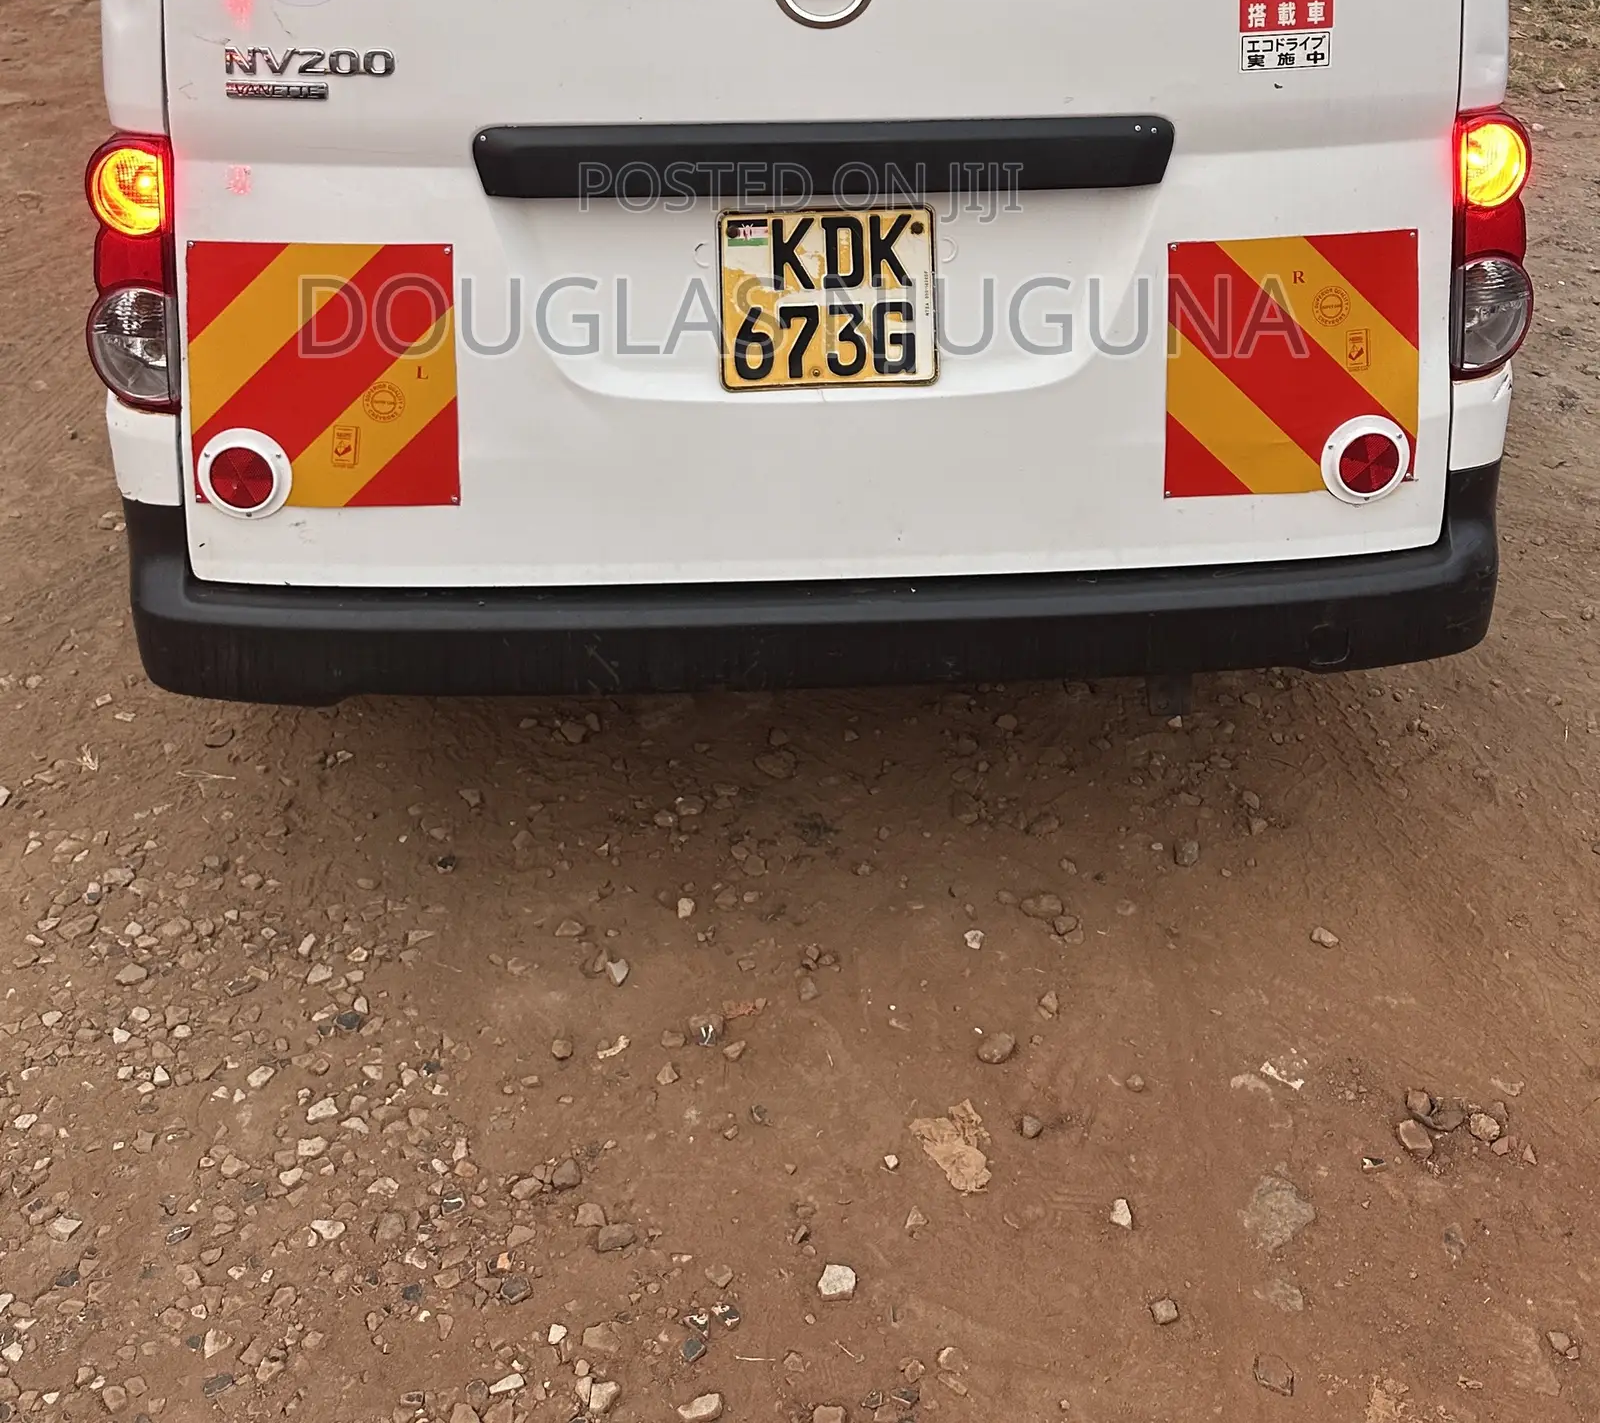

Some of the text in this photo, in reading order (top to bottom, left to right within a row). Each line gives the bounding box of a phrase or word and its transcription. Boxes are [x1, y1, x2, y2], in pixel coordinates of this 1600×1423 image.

[1247, 0, 1326, 28] 搭載車
[1246, 34, 1327, 53] エコドライブ
[224, 46, 396, 76] NV200
[1247, 51, 1325, 68] 実施中
[234, 83, 321, 98] VANETTE
[770, 213, 912, 291] KDK
[1292, 270, 1306, 285] R
[733, 301, 918, 381] 673G
[416, 366, 429, 380] L
